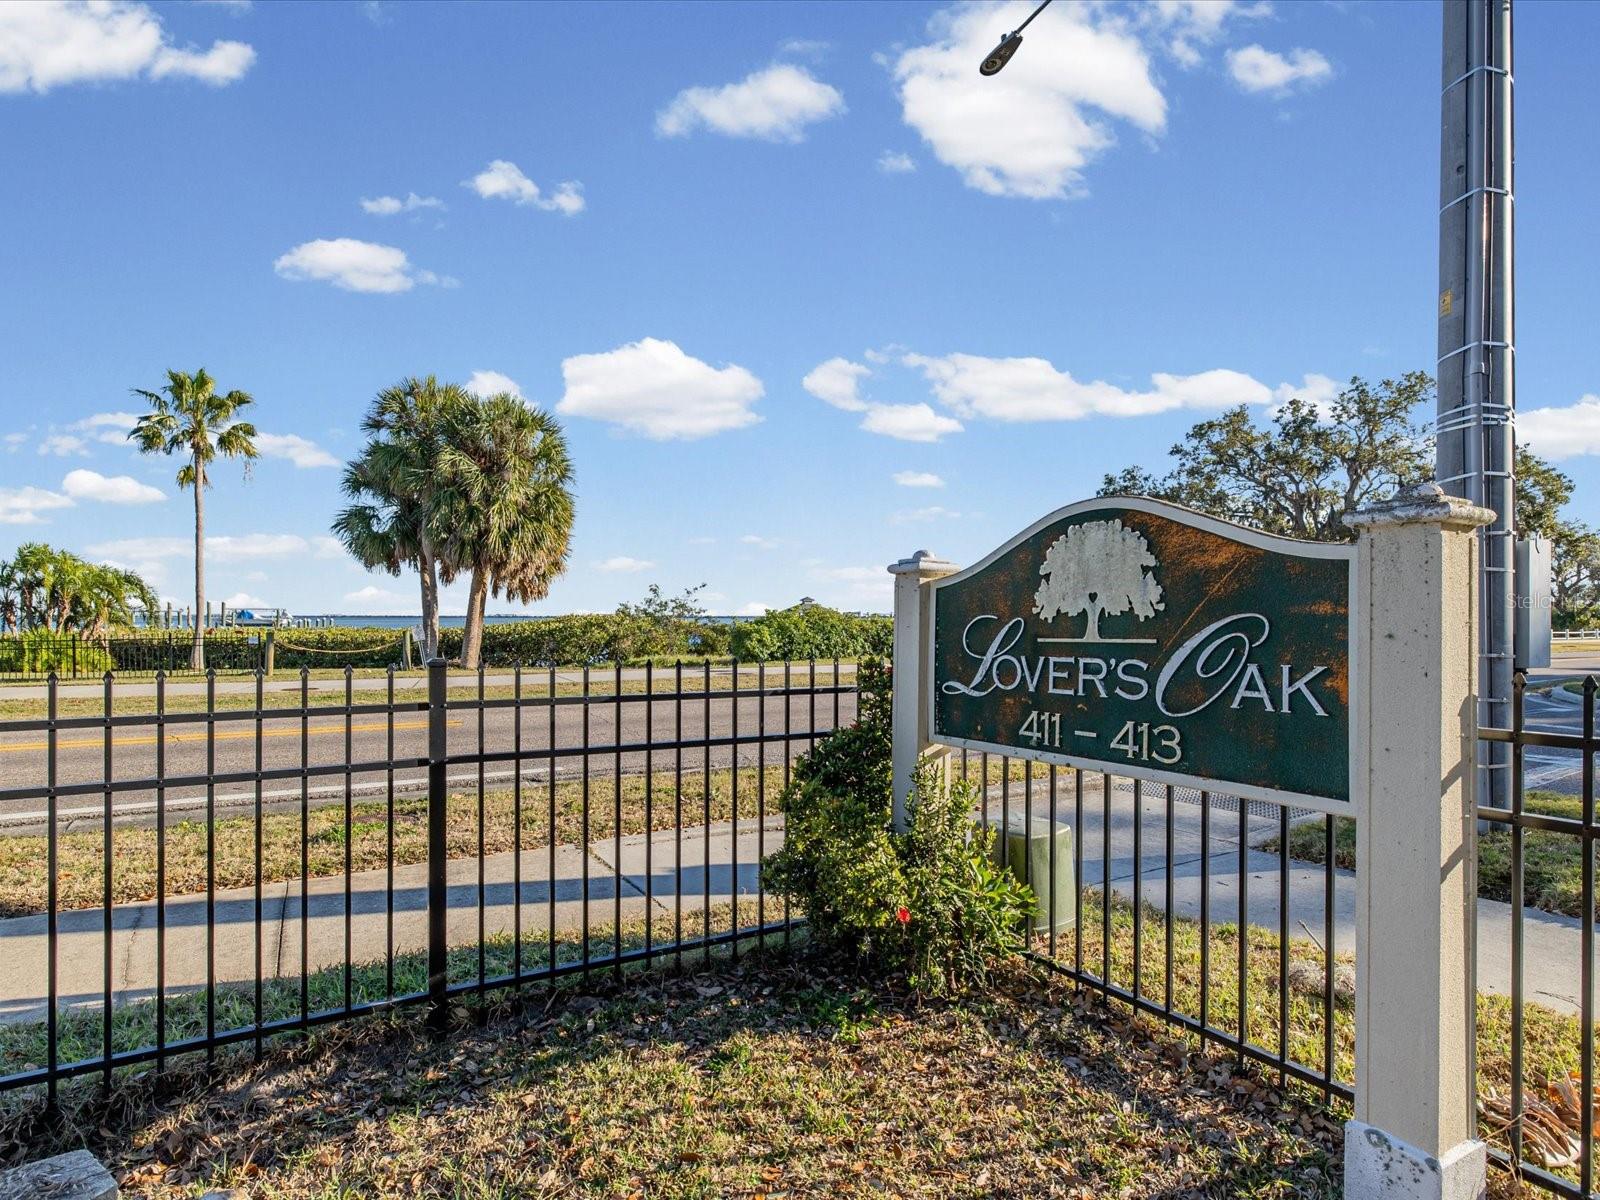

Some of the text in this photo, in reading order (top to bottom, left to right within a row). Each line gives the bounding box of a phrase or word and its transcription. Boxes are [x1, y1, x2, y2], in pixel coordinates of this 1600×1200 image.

[942, 613, 1329, 717] LOVER'S OAK
[1018, 710, 1061, 748] 411
[1109, 720, 1182, 764] 413
